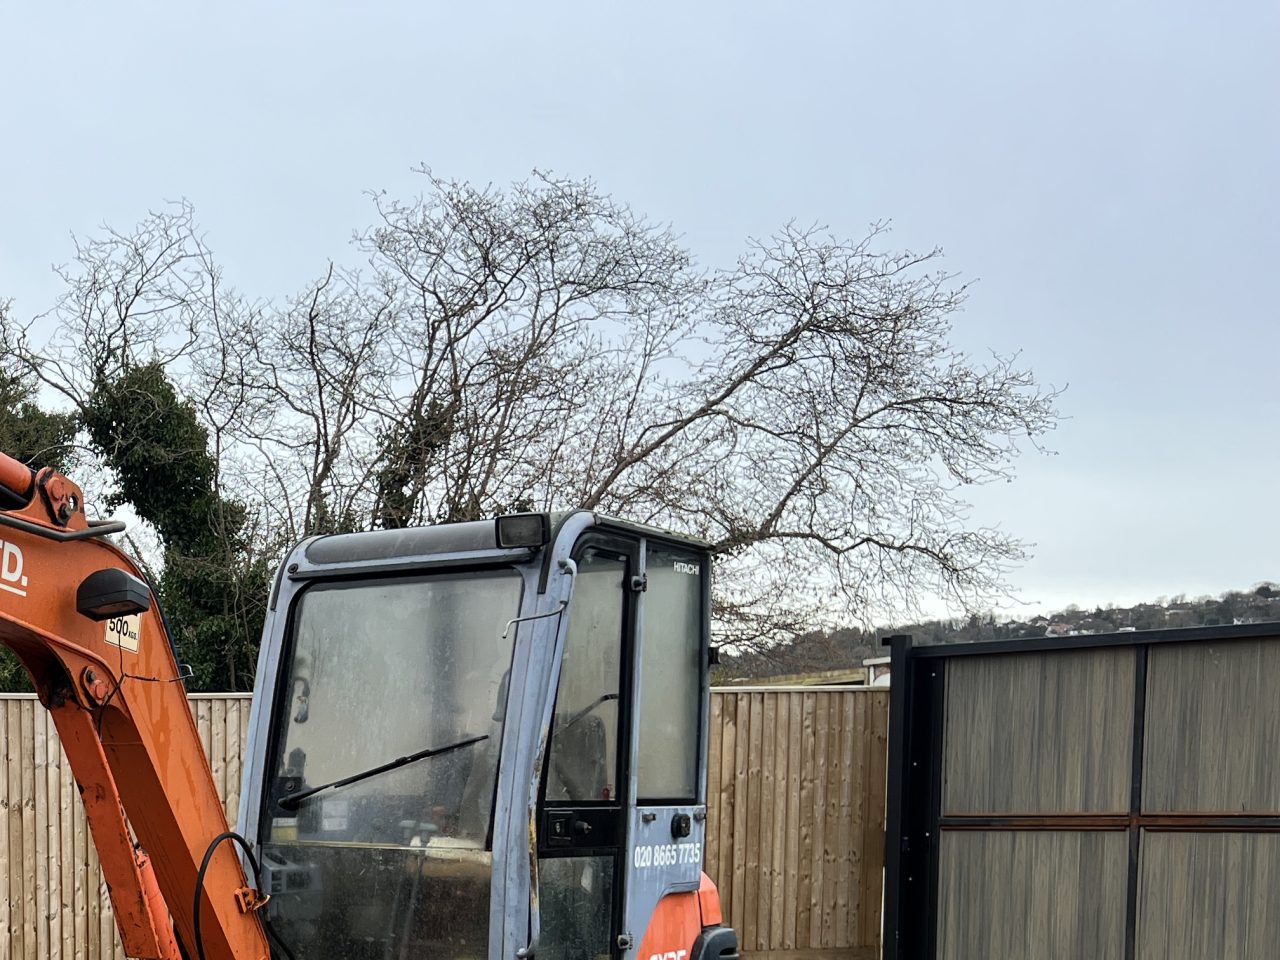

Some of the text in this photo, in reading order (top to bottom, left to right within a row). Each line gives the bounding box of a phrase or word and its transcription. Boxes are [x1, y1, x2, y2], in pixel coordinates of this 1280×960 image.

[673, 561, 700, 576] HITACHI
[109, 617, 129, 637] 500
[634, 842, 701, 868] 020 8665 7735
